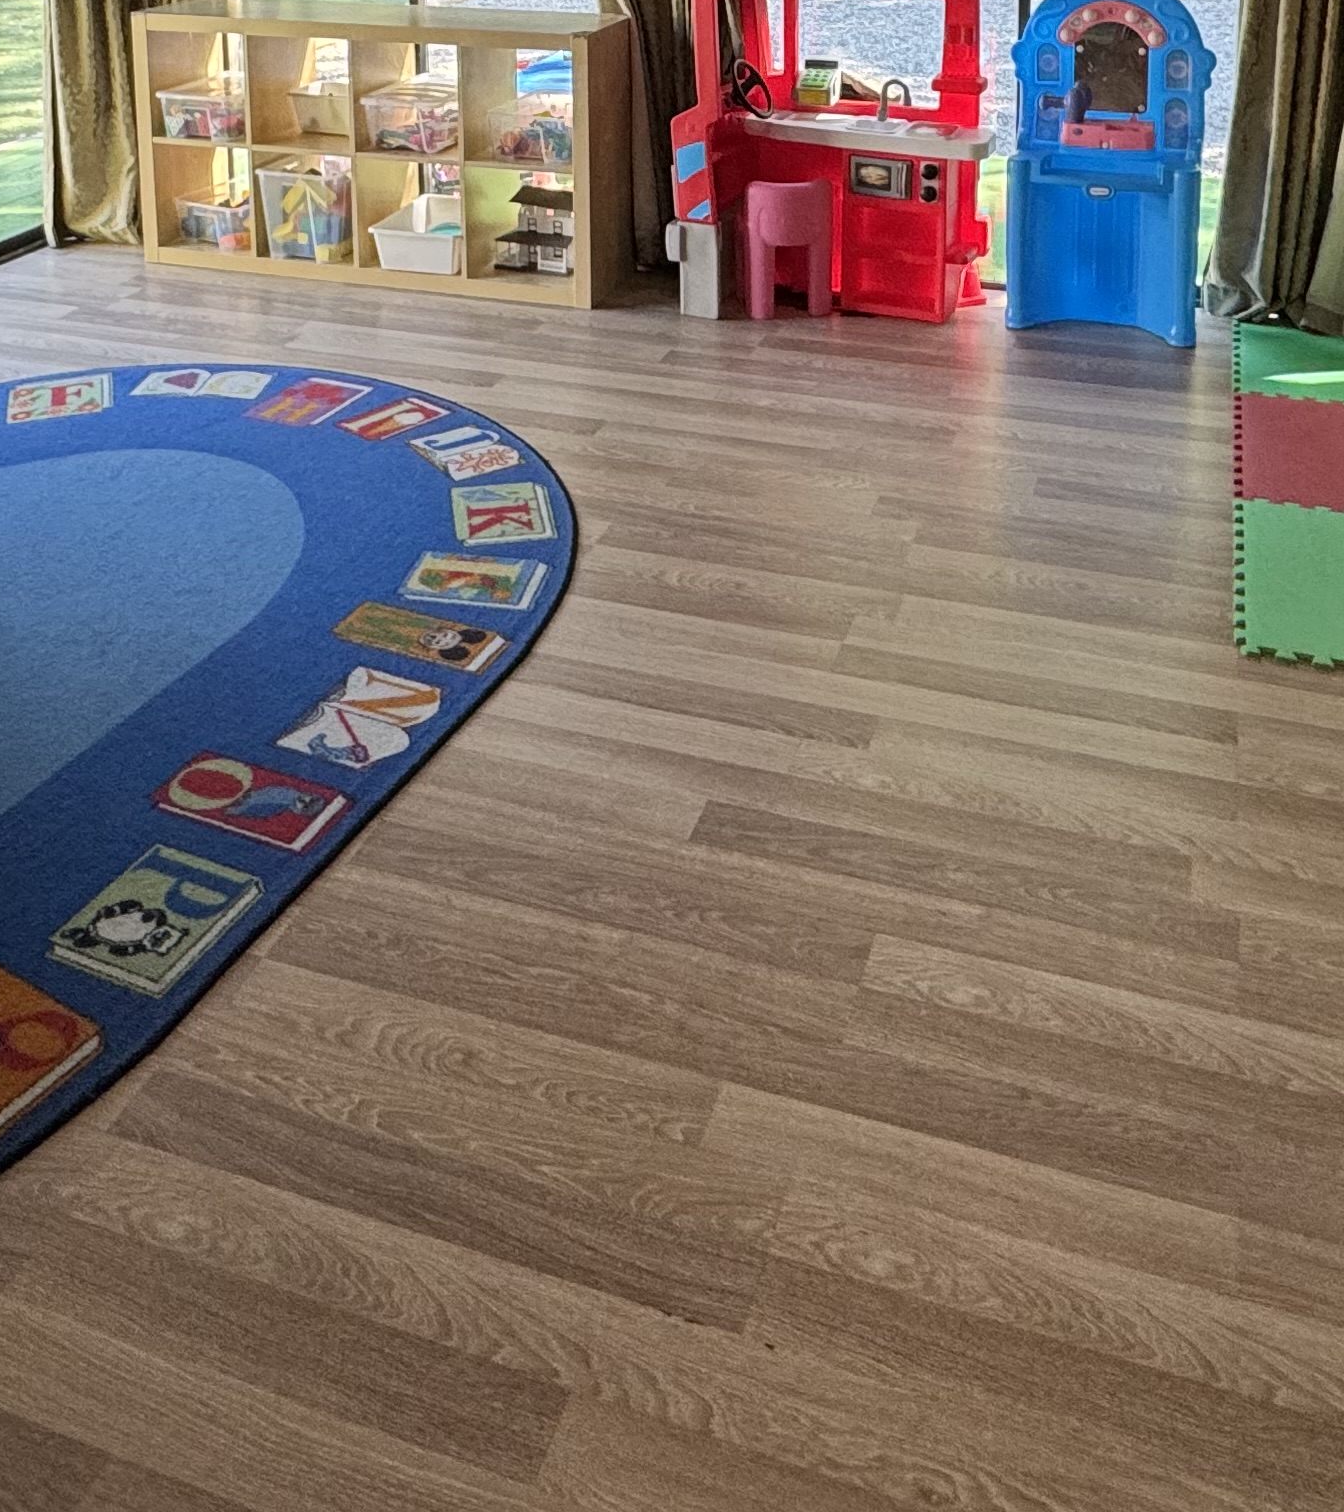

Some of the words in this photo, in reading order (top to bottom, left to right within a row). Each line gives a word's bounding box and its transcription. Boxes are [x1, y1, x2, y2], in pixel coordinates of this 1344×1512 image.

[466, 500, 535, 537] K
[341, 669, 440, 724] N
[168, 757, 254, 811] O
[131, 850, 244, 920] P
